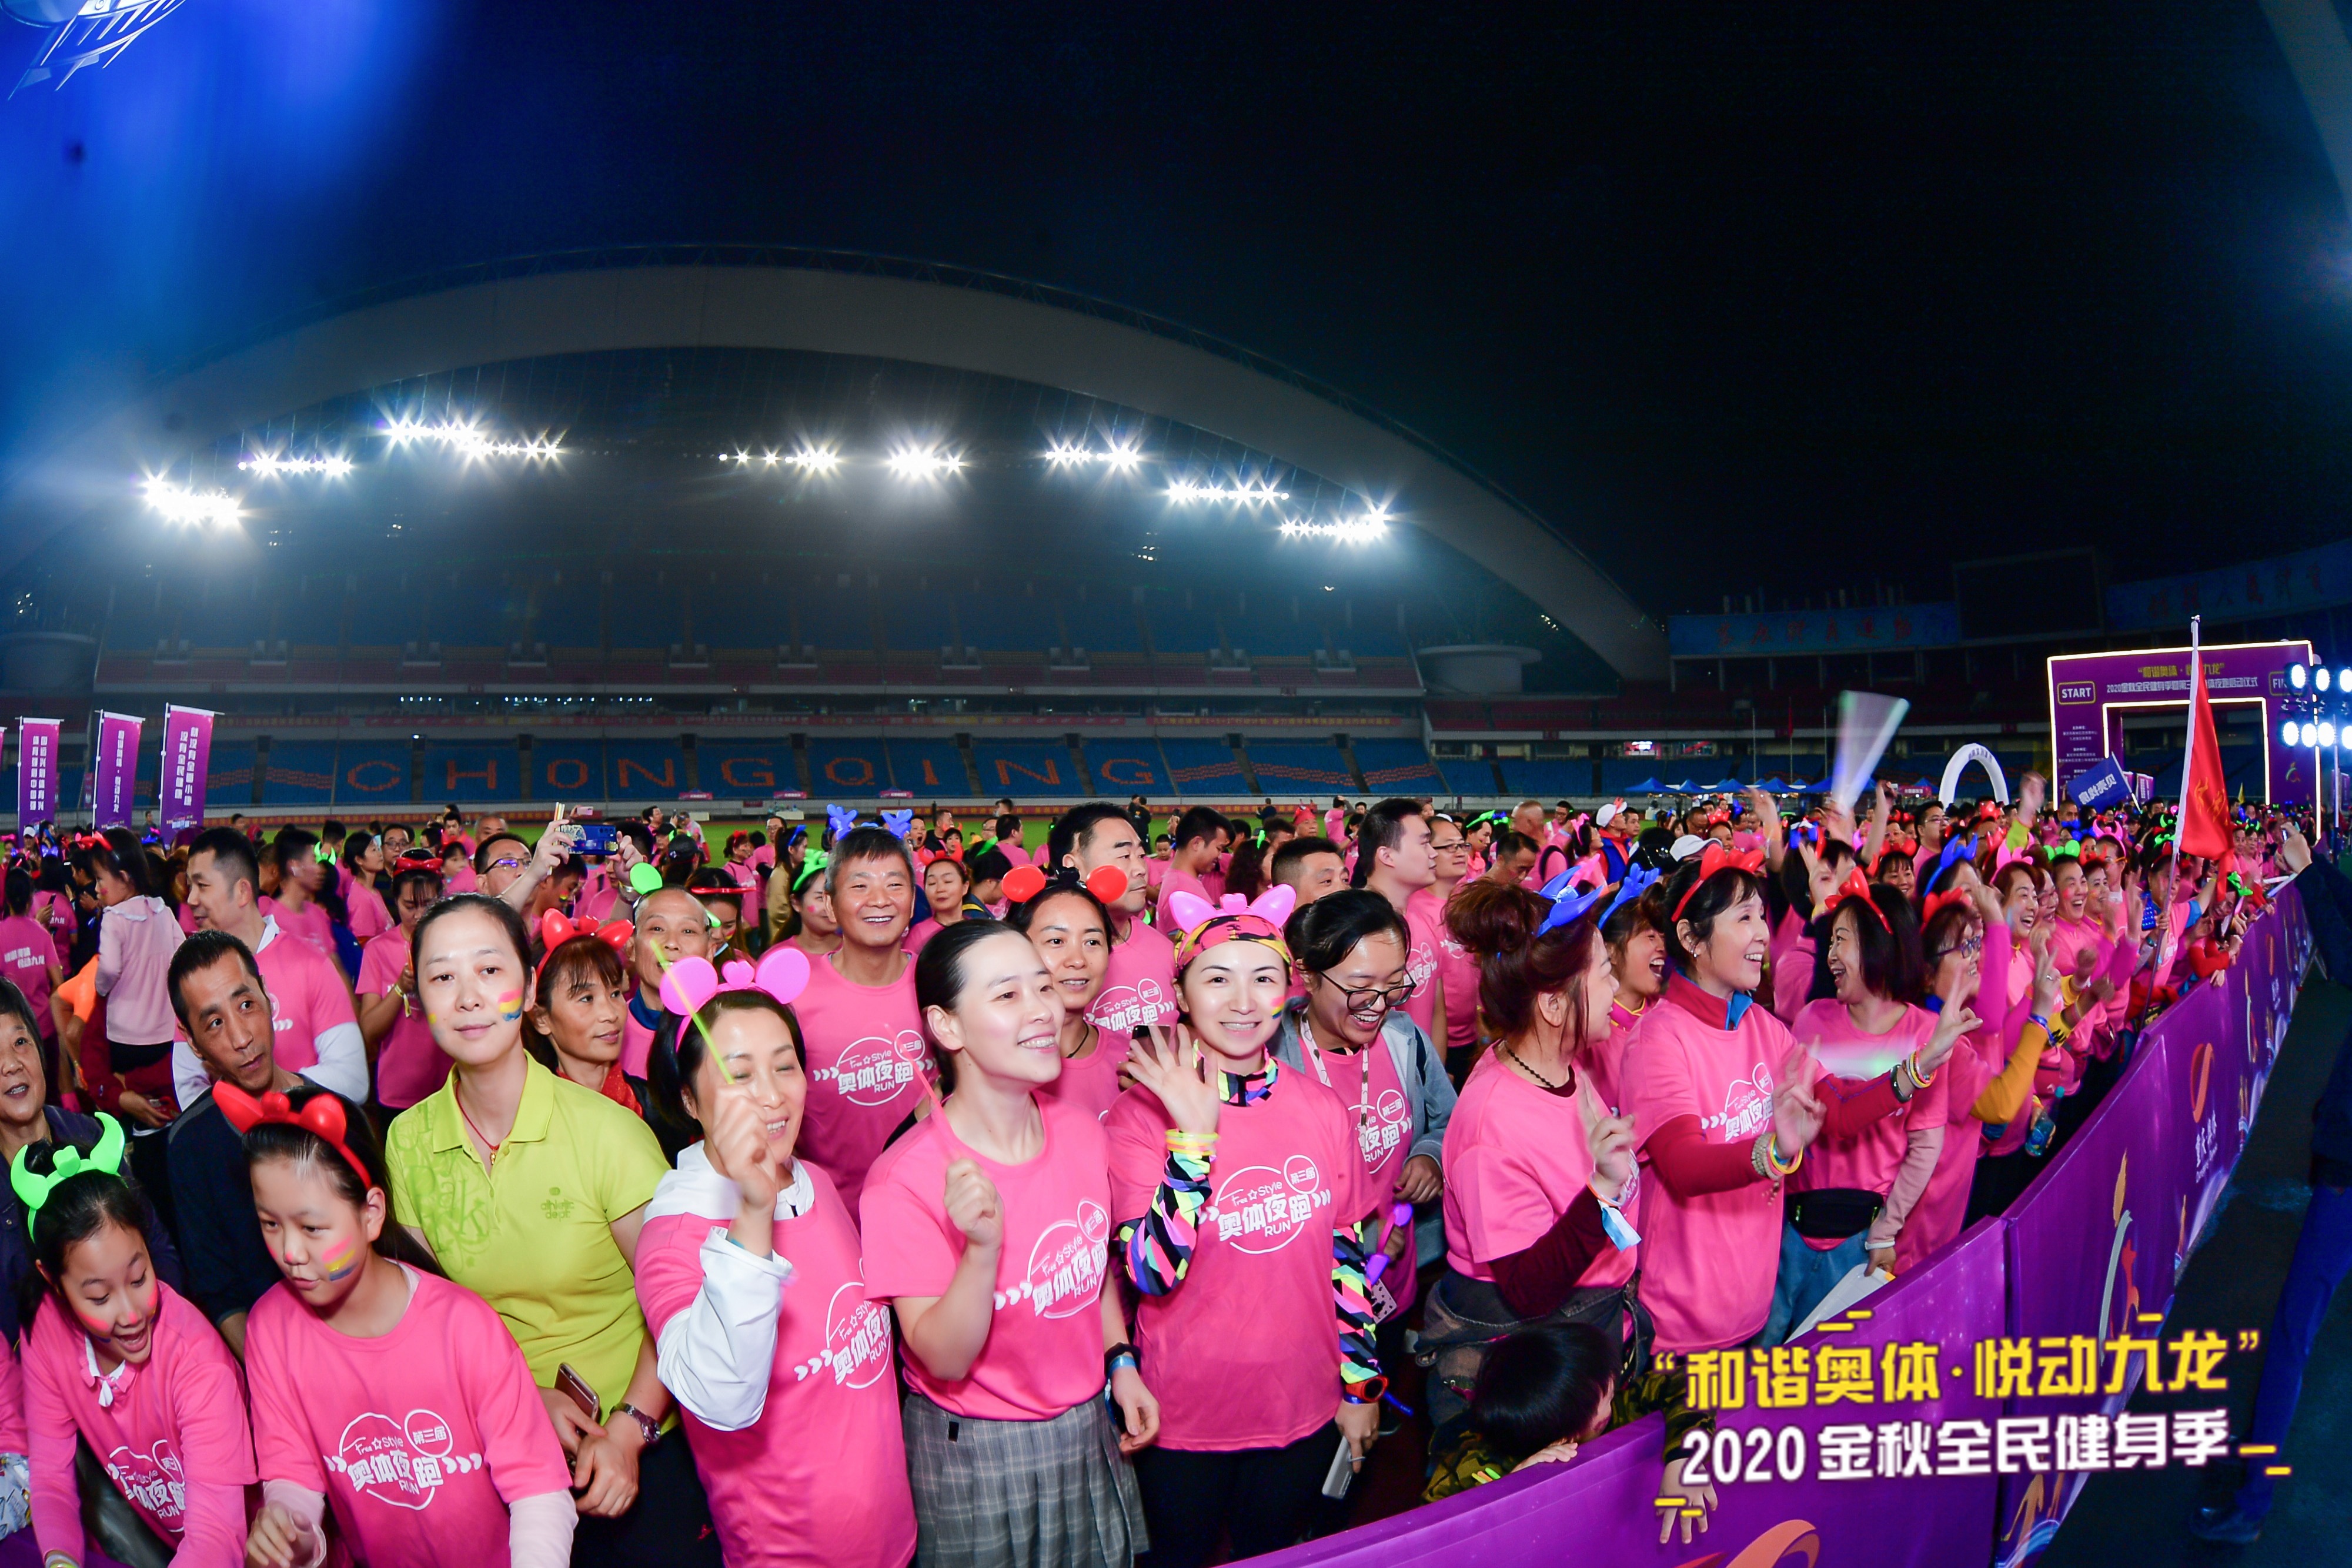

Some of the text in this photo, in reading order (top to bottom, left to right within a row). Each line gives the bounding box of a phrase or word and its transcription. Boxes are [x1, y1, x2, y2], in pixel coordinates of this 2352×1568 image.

[2062, 687, 2092, 698] START
[347, 758, 1155, 791] CHONGQING
[871, 1050, 892, 1062] Style
[838, 1059, 914, 1095] 奥体夜跑
[874, 1081, 895, 1093] RUN
[1382, 1098, 1402, 1117] 第三届
[1365, 1147, 1384, 1162] RUN
[1290, 1166, 1316, 1184] 第三届
[1258, 1181, 1282, 1196] Style
[1218, 1192, 1312, 1242] 奥体夜跑
[1265, 1220, 1291, 1237] RUN
[1063, 1235, 1083, 1258] Style
[1033, 1241, 1108, 1317] 奥体夜跑
[1074, 1272, 1097, 1298] RUN
[870, 1337, 887, 1364] RUN
[382, 1436, 404, 1449] Style
[412, 1426, 447, 1445] 第三届
[348, 1449, 444, 1492] 奥体夜跑
[398, 1479, 420, 1495] RUN
[156, 1505, 180, 1519] RUN
